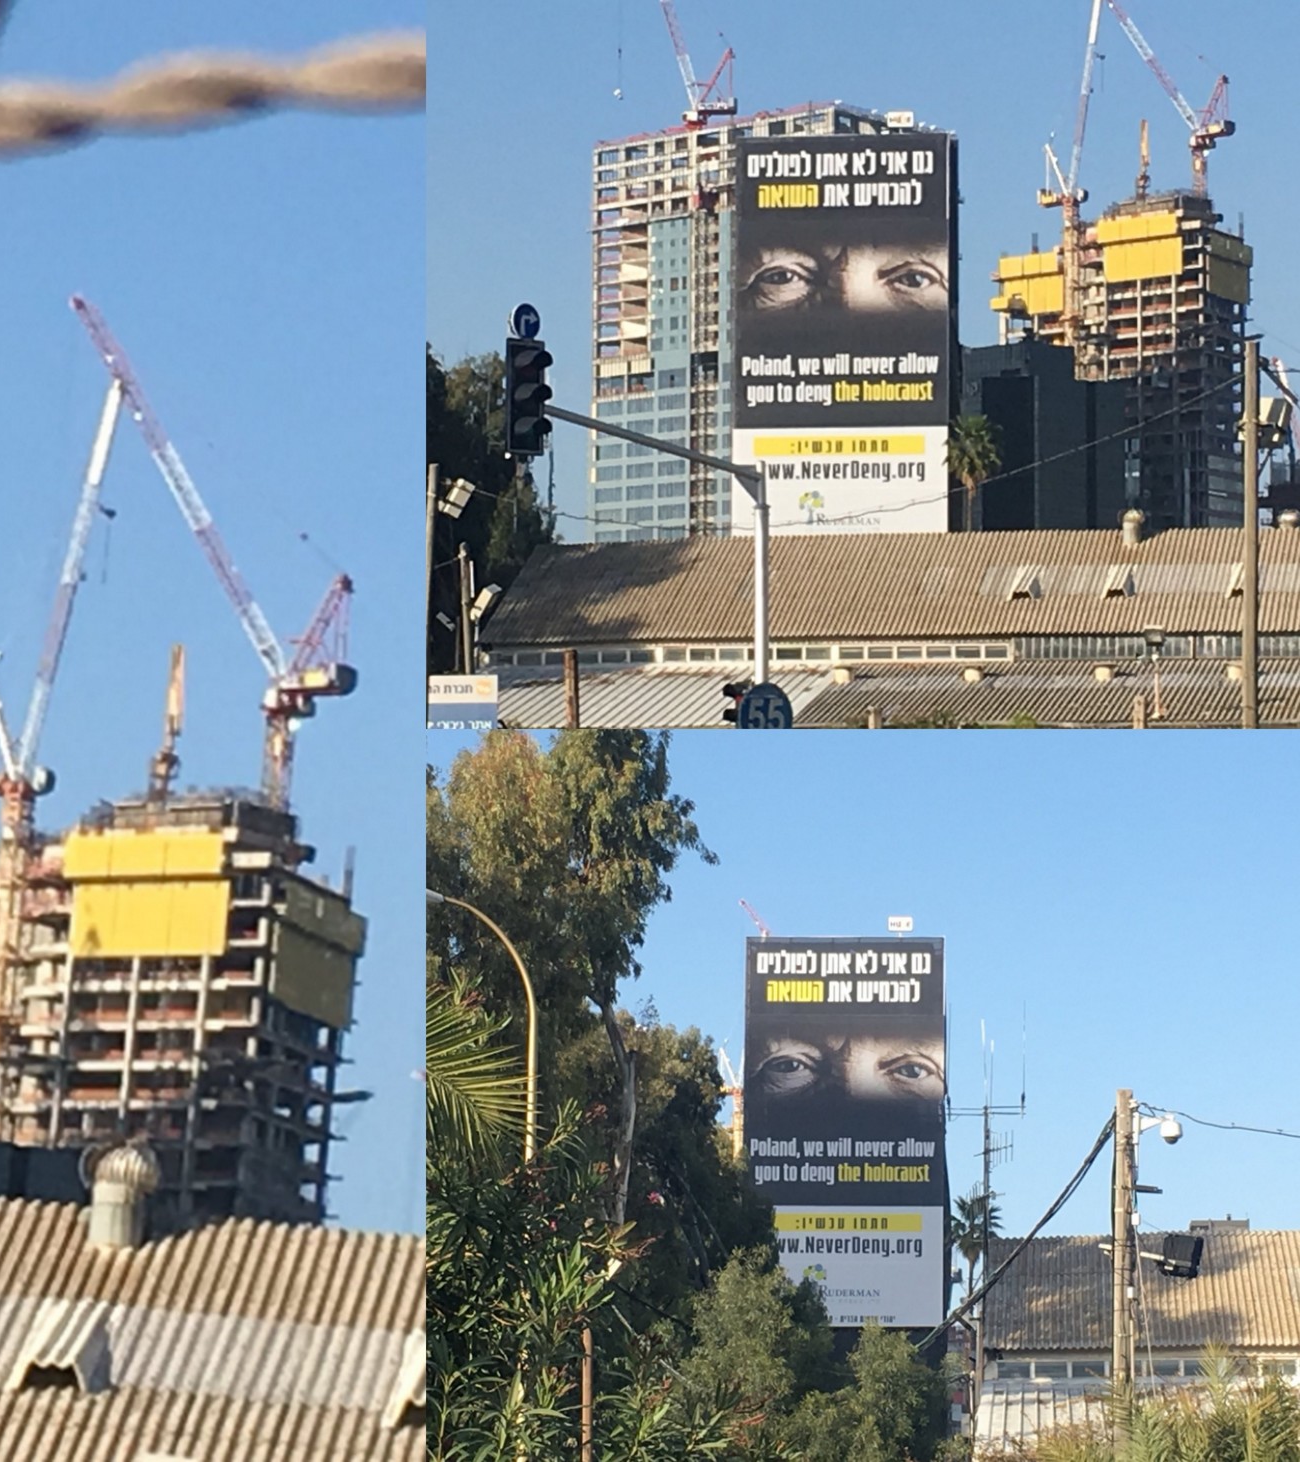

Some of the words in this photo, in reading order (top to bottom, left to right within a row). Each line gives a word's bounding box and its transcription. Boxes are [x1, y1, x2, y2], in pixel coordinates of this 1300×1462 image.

[747, 150, 811, 178] לפולנים
[815, 152, 849, 180] אתן
[852, 148, 876, 177] לא
[880, 150, 908, 176] אני
[912, 150, 934, 175] גם
[758, 183, 819, 209] השואה
[822, 182, 850, 208] את
[853, 178, 922, 208] להכחיש
[741, 353, 796, 378] Poland,
[798, 357, 820, 376] we
[823, 353, 850, 376] will
[852, 356, 896, 375] never
[898, 352, 939, 375] allow
[747, 384, 775, 407] you
[777, 382, 794, 403] to
[795, 381, 832, 406] deny
[834, 380, 860, 402] the
[862, 379, 934, 401] holocaust
[767, 460, 926, 483] ww.NeverDeny.org
[756, 949, 817, 975] לפולנים
[821, 952, 852, 977] אתן
[855, 949, 878, 974] לא
[881, 952, 907, 974] אני
[911, 952, 932, 974] גם
[766, 980, 824, 1002] השואה
[827, 980, 852, 1002] את
[856, 978, 921, 1002] להכחיש
[750, 1137, 800, 1159] Poland,
[803, 1140, 824, 1157] we
[826, 1138, 851, 1157] will
[854, 1140, 895, 1157] never
[897, 1138, 935, 1157] allow
[754, 1165, 780, 1185] you
[783, 1164, 798, 1182] to
[800, 1163, 835, 1186] deny
[838, 1163, 861, 1182] the
[863, 1163, 930, 1182] holocaust
[777, 1236, 923, 1257] ww.NeverDeny.org
